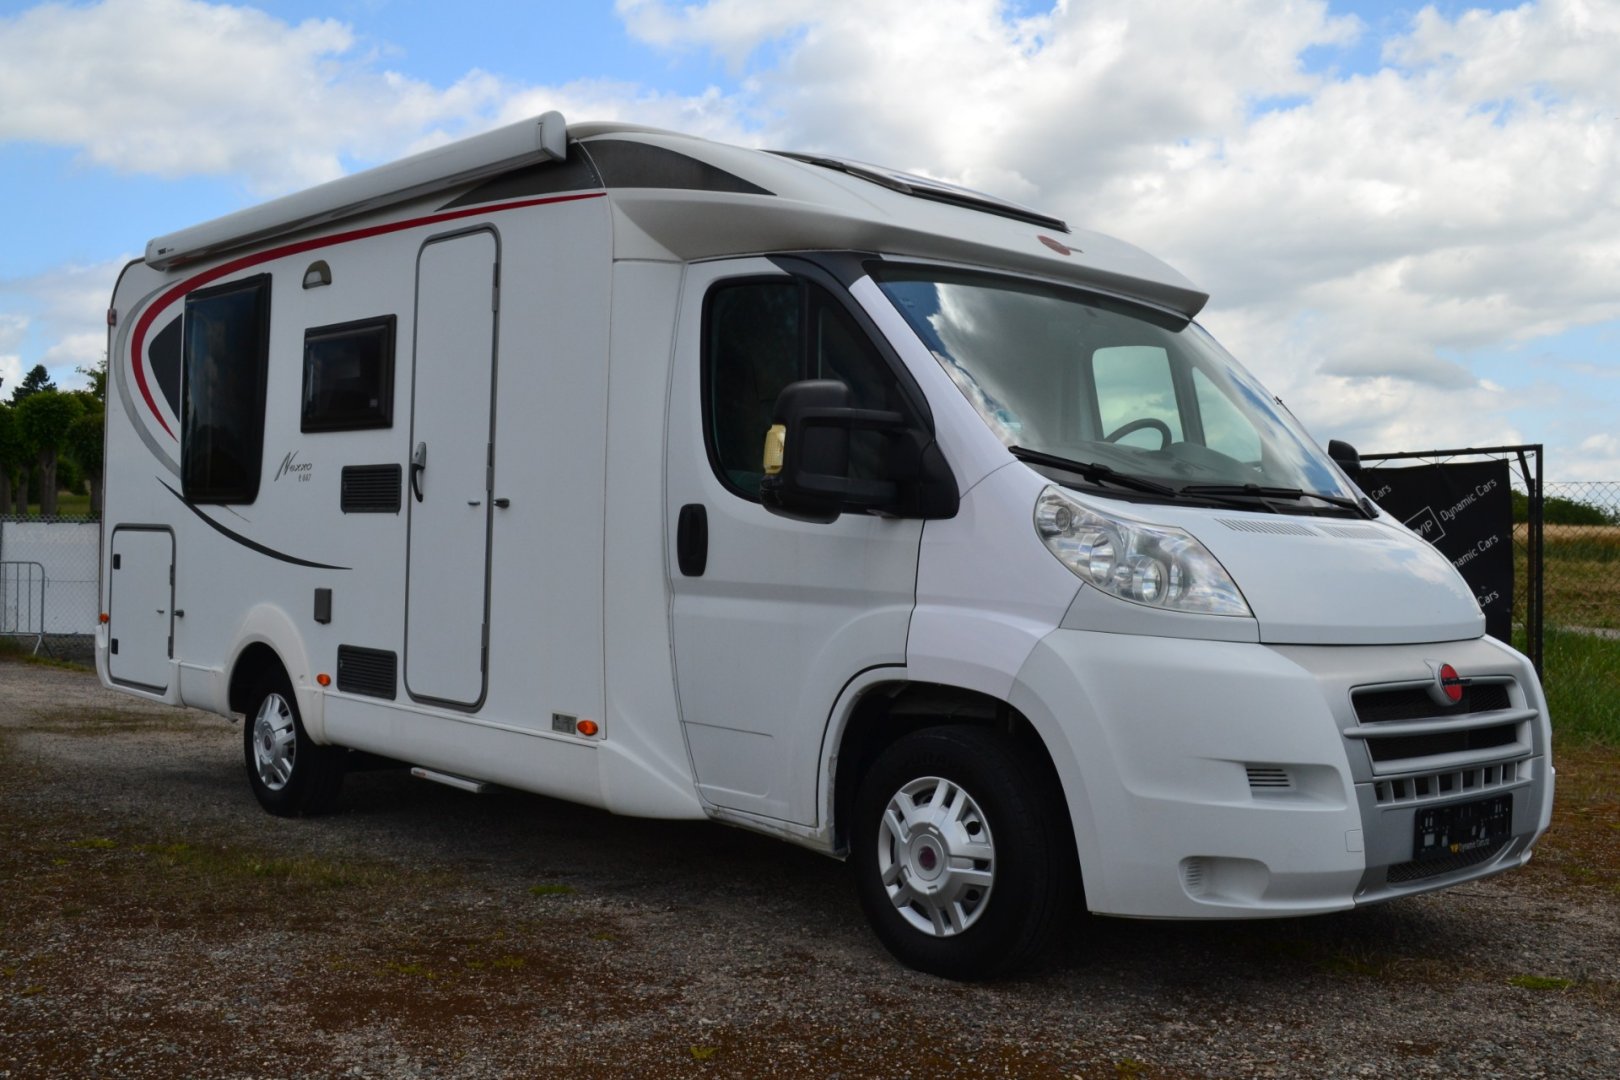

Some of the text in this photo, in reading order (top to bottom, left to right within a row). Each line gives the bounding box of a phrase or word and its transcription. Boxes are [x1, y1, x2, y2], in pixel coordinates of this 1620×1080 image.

[1371, 485, 1392, 502] Cars
[1440, 479, 1497, 521] Dynamic Cars
[1453, 535, 1499, 568] namic Cars
[1477, 591, 1499, 607] Cars
